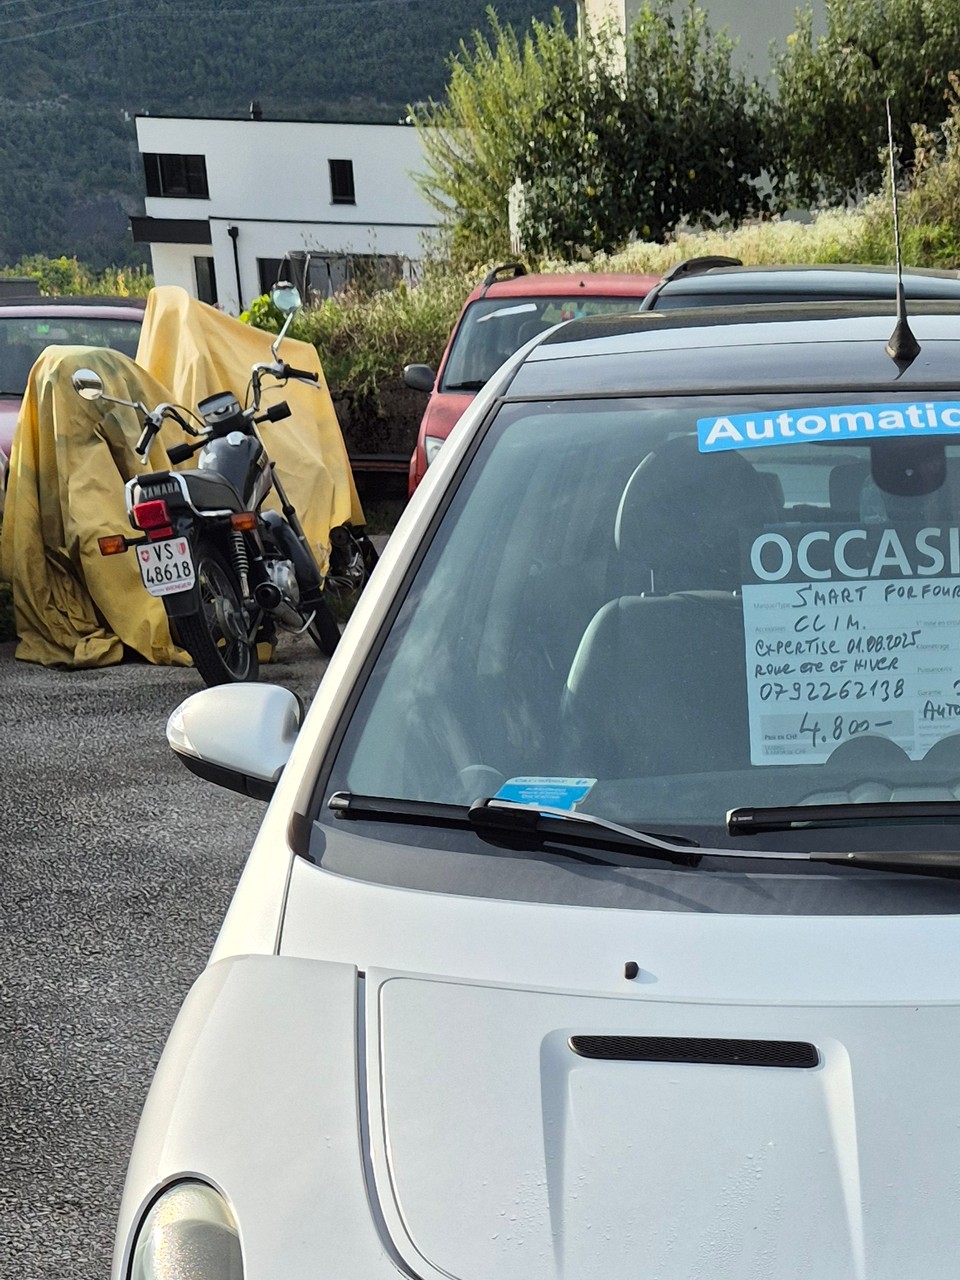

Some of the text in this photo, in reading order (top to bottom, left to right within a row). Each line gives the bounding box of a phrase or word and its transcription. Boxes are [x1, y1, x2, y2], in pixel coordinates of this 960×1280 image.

[142, 482, 180, 499] YAMAHA
[152, 543, 174, 562] VS
[146, 560, 192, 585] 48618
[791, 584, 868, 608] SMART
[759, 677, 905, 703] 0792262138
